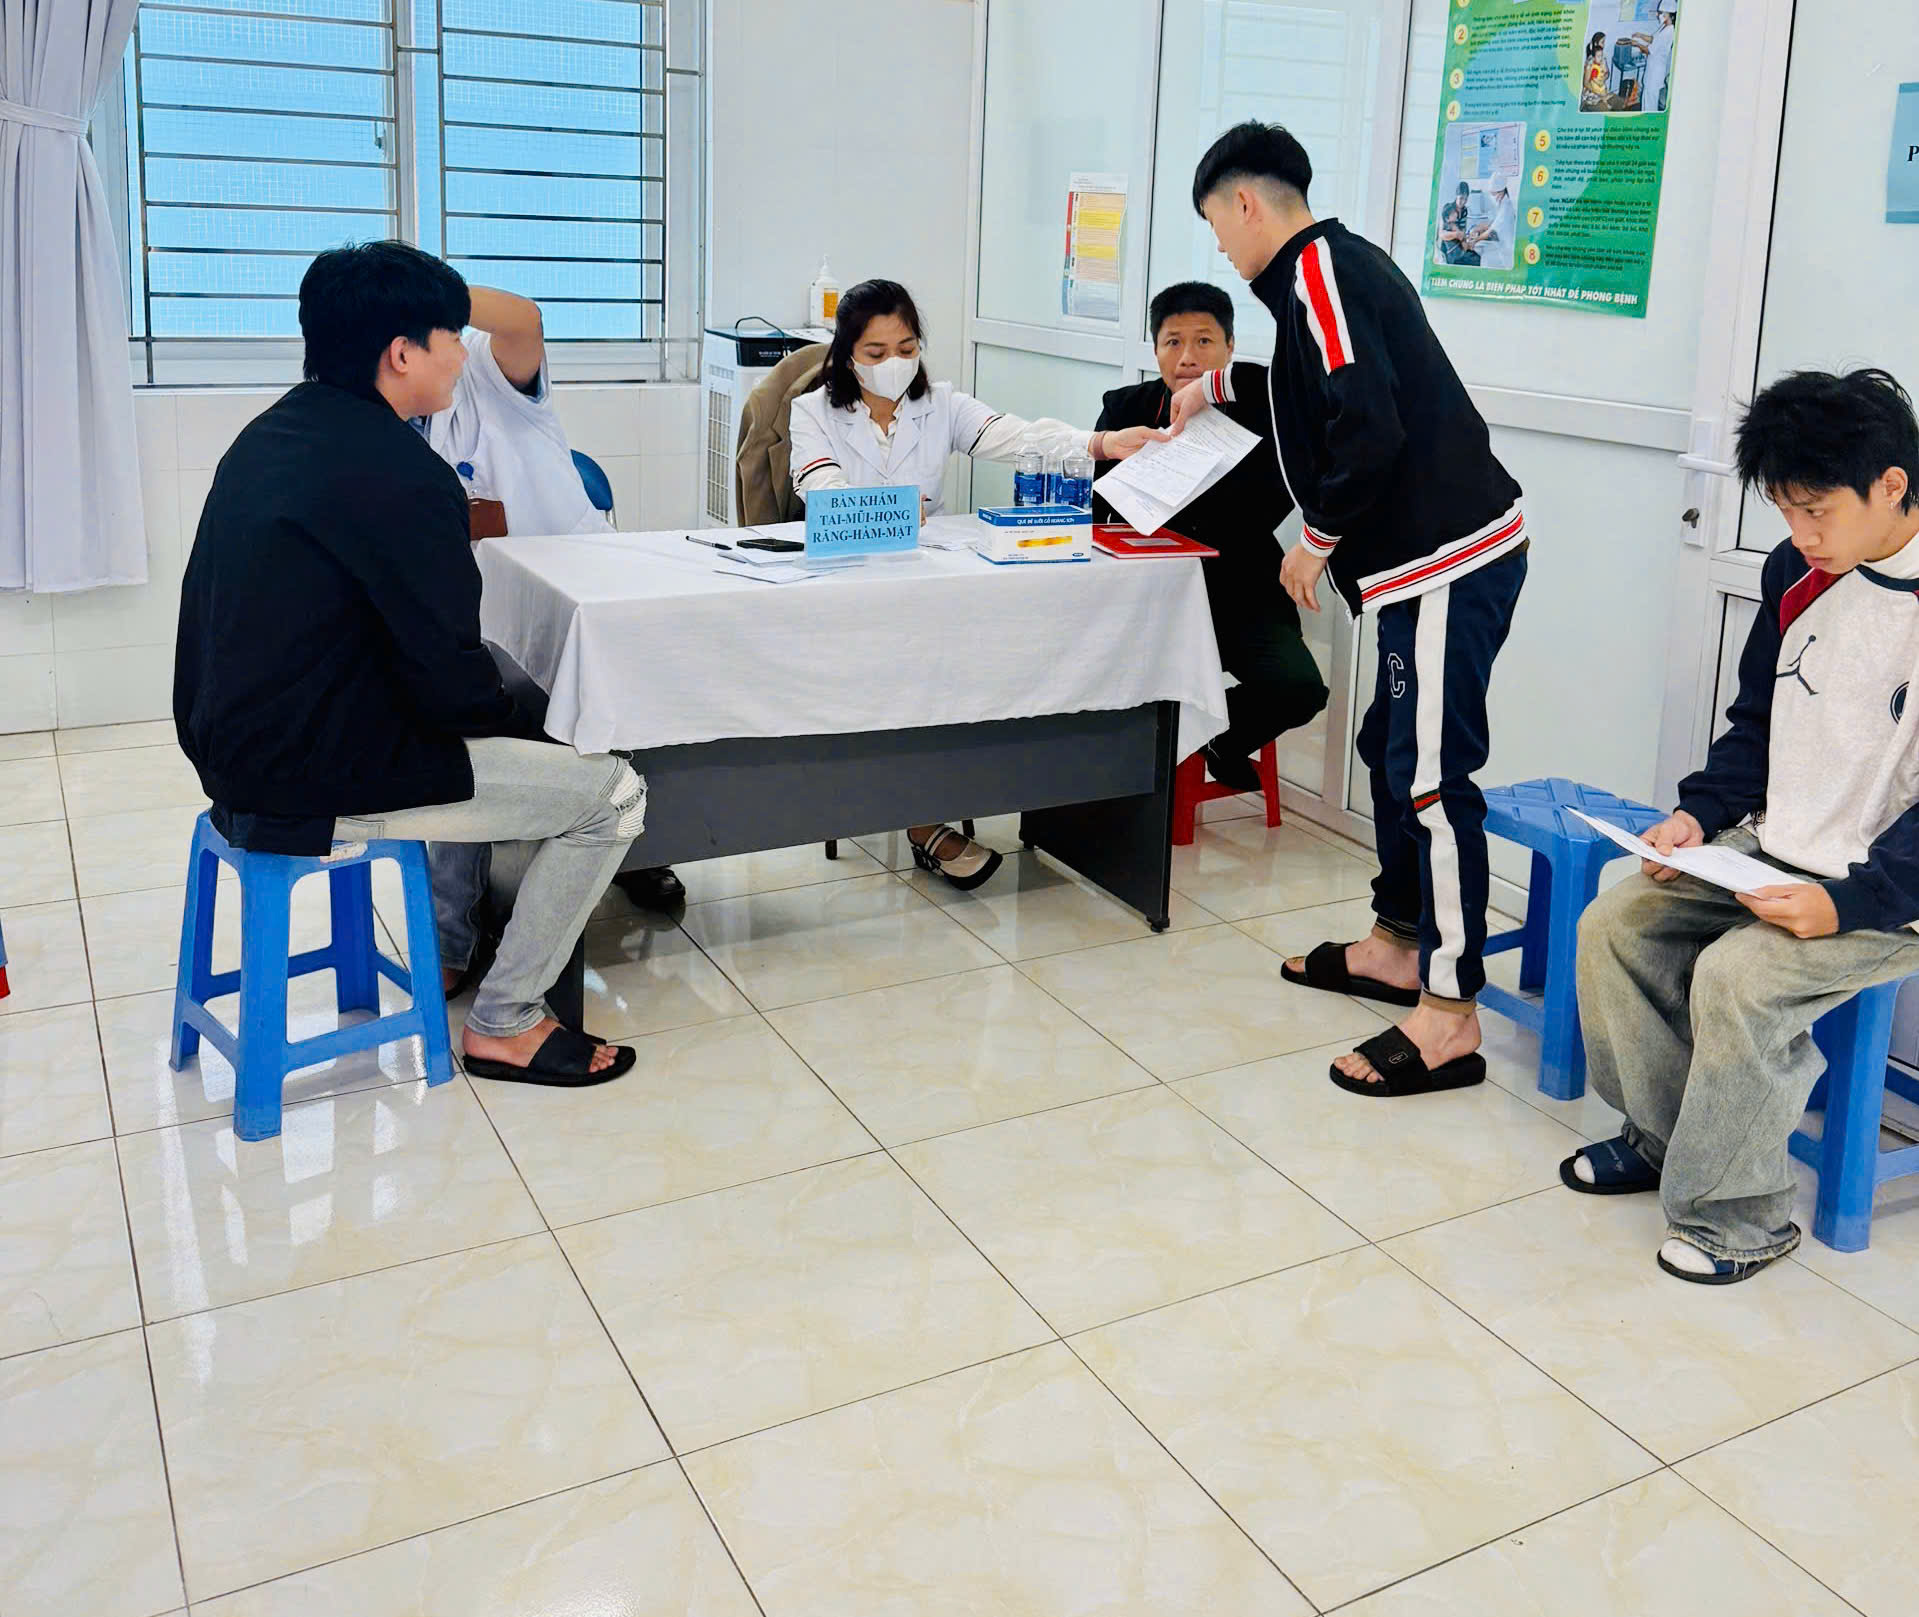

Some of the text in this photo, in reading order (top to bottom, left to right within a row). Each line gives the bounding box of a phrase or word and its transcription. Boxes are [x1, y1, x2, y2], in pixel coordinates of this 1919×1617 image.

[1614, 291, 1639, 306] BỆNH
[859, 492, 897, 507] KHÁM
[820, 509, 910, 526] TAI-MŨI-HỌNG
[812, 525, 913, 543] RĂNG-HÀM-MẶT
[1387, 652, 1406, 699] C
